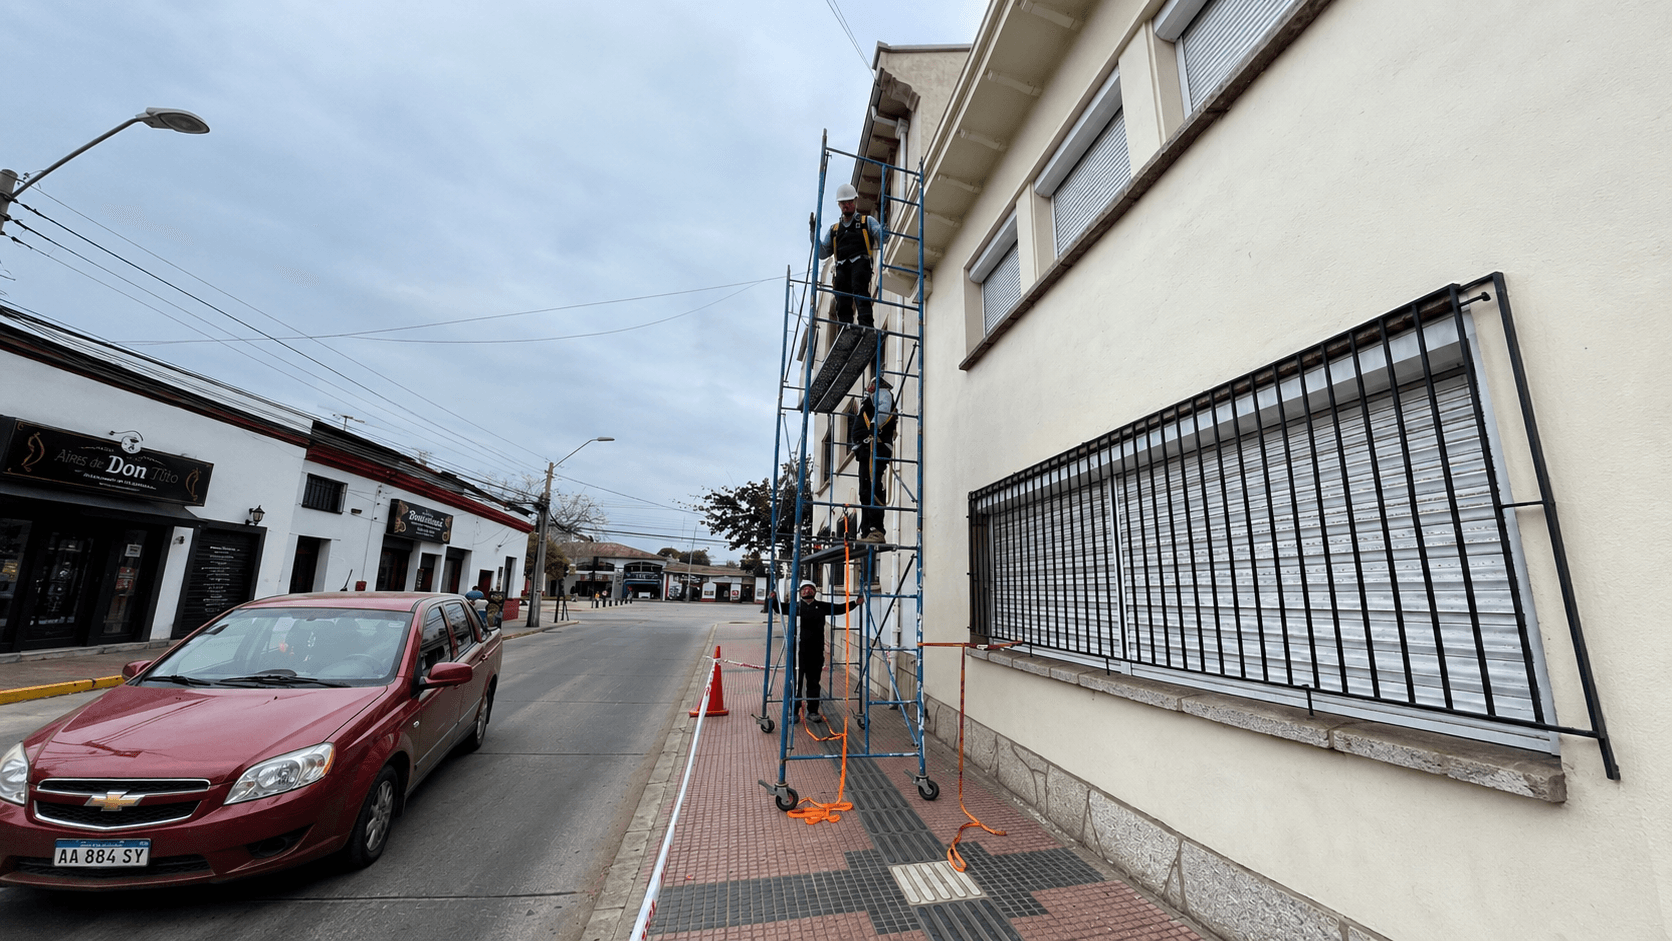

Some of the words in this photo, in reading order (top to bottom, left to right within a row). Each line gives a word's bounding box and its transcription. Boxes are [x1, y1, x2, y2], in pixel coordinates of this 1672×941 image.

[106, 455, 147, 479] Don
[58, 849, 79, 864] AA
[85, 849, 116, 864] 884
[122, 849, 144, 864] SY
